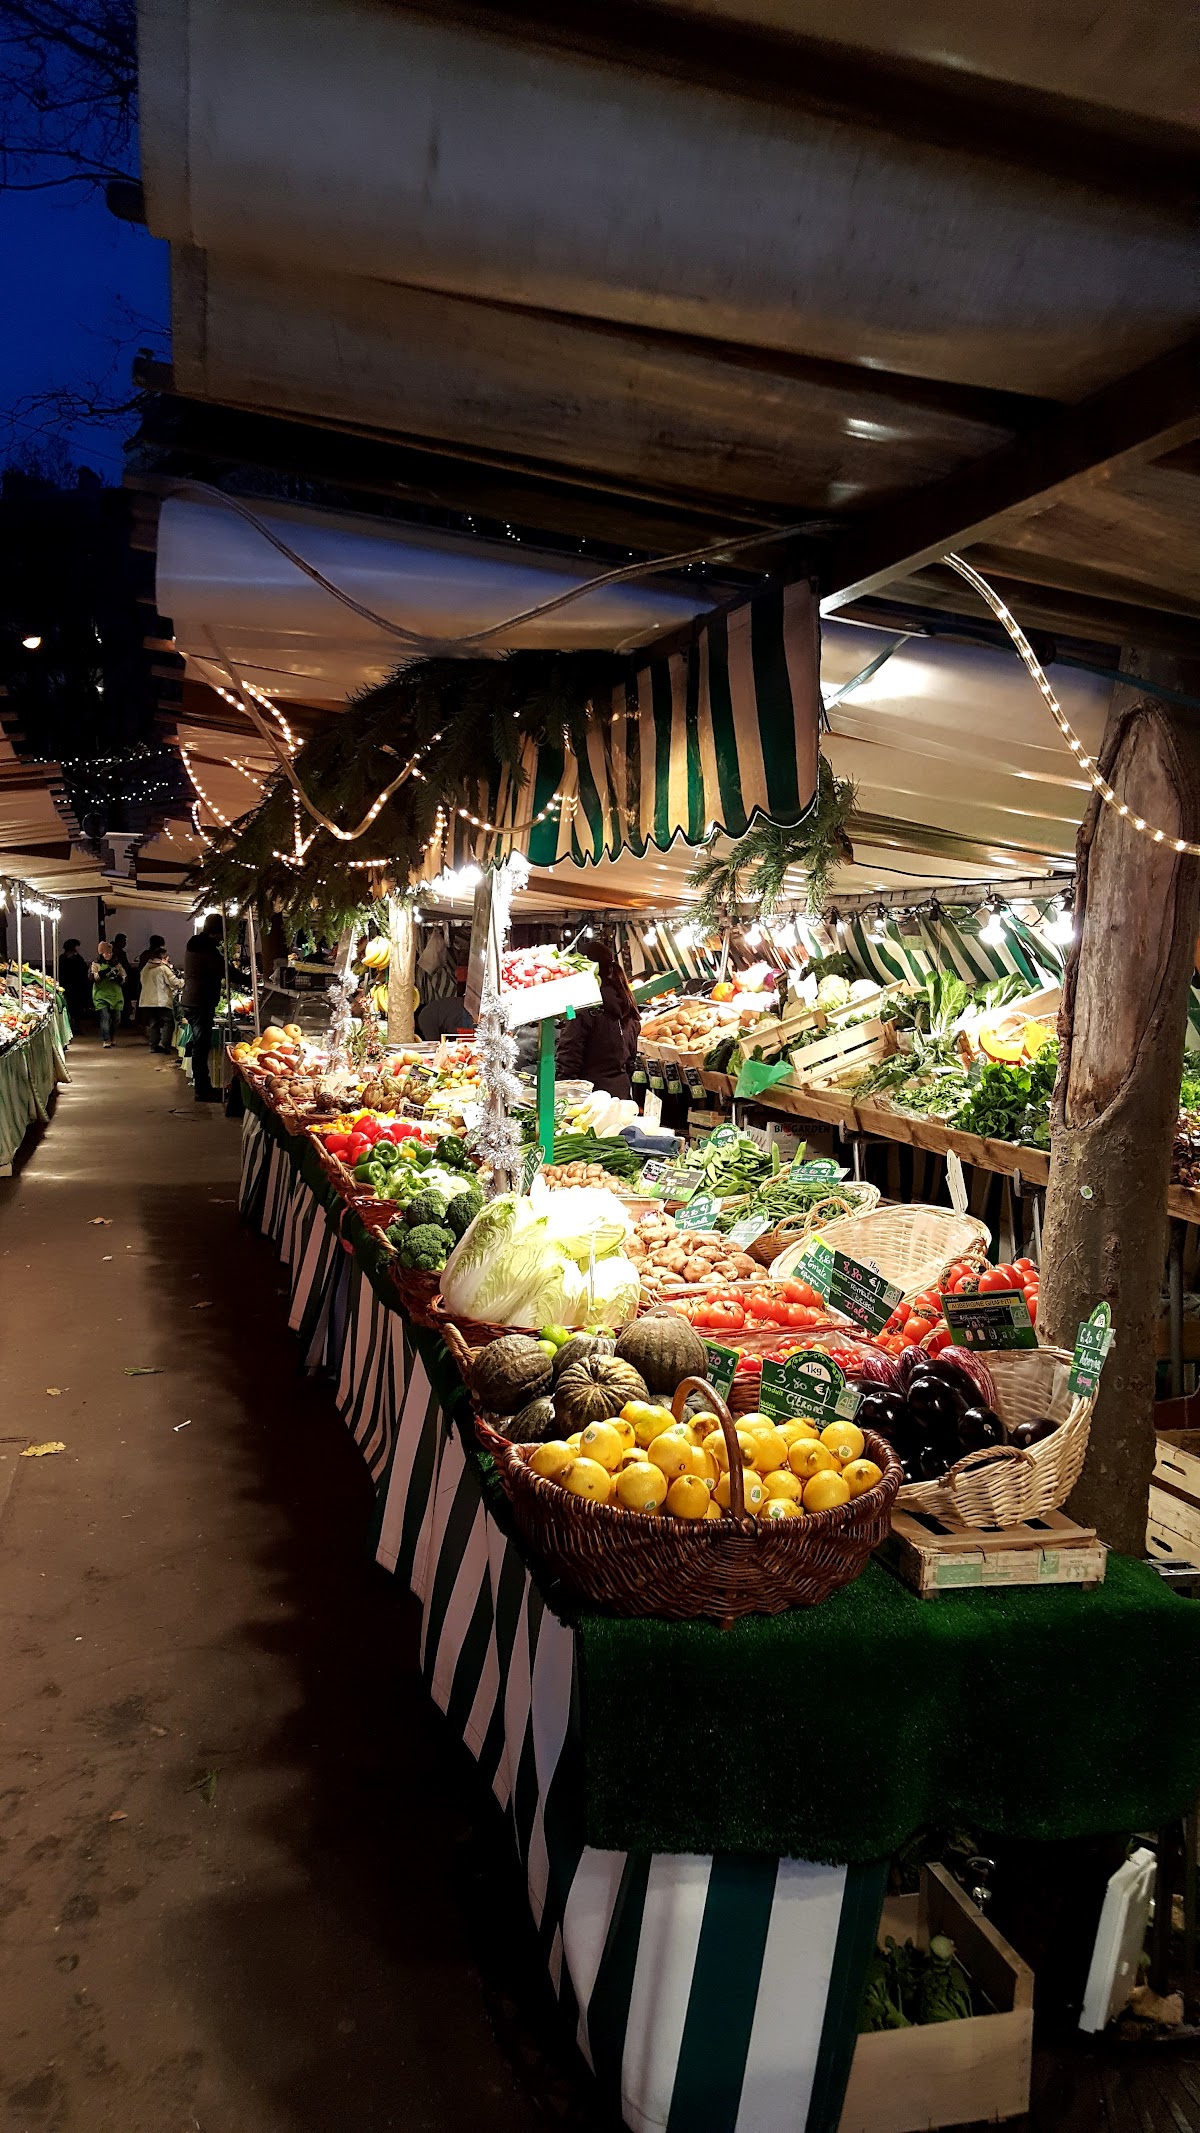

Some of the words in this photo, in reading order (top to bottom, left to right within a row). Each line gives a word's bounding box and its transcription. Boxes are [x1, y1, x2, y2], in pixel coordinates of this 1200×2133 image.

[843, 1260, 863, 1281] 8,80
[805, 1364, 823, 1376] 1kg
[774, 1368, 808, 1389] 3,80
[761, 1384, 784, 1396] Produit
